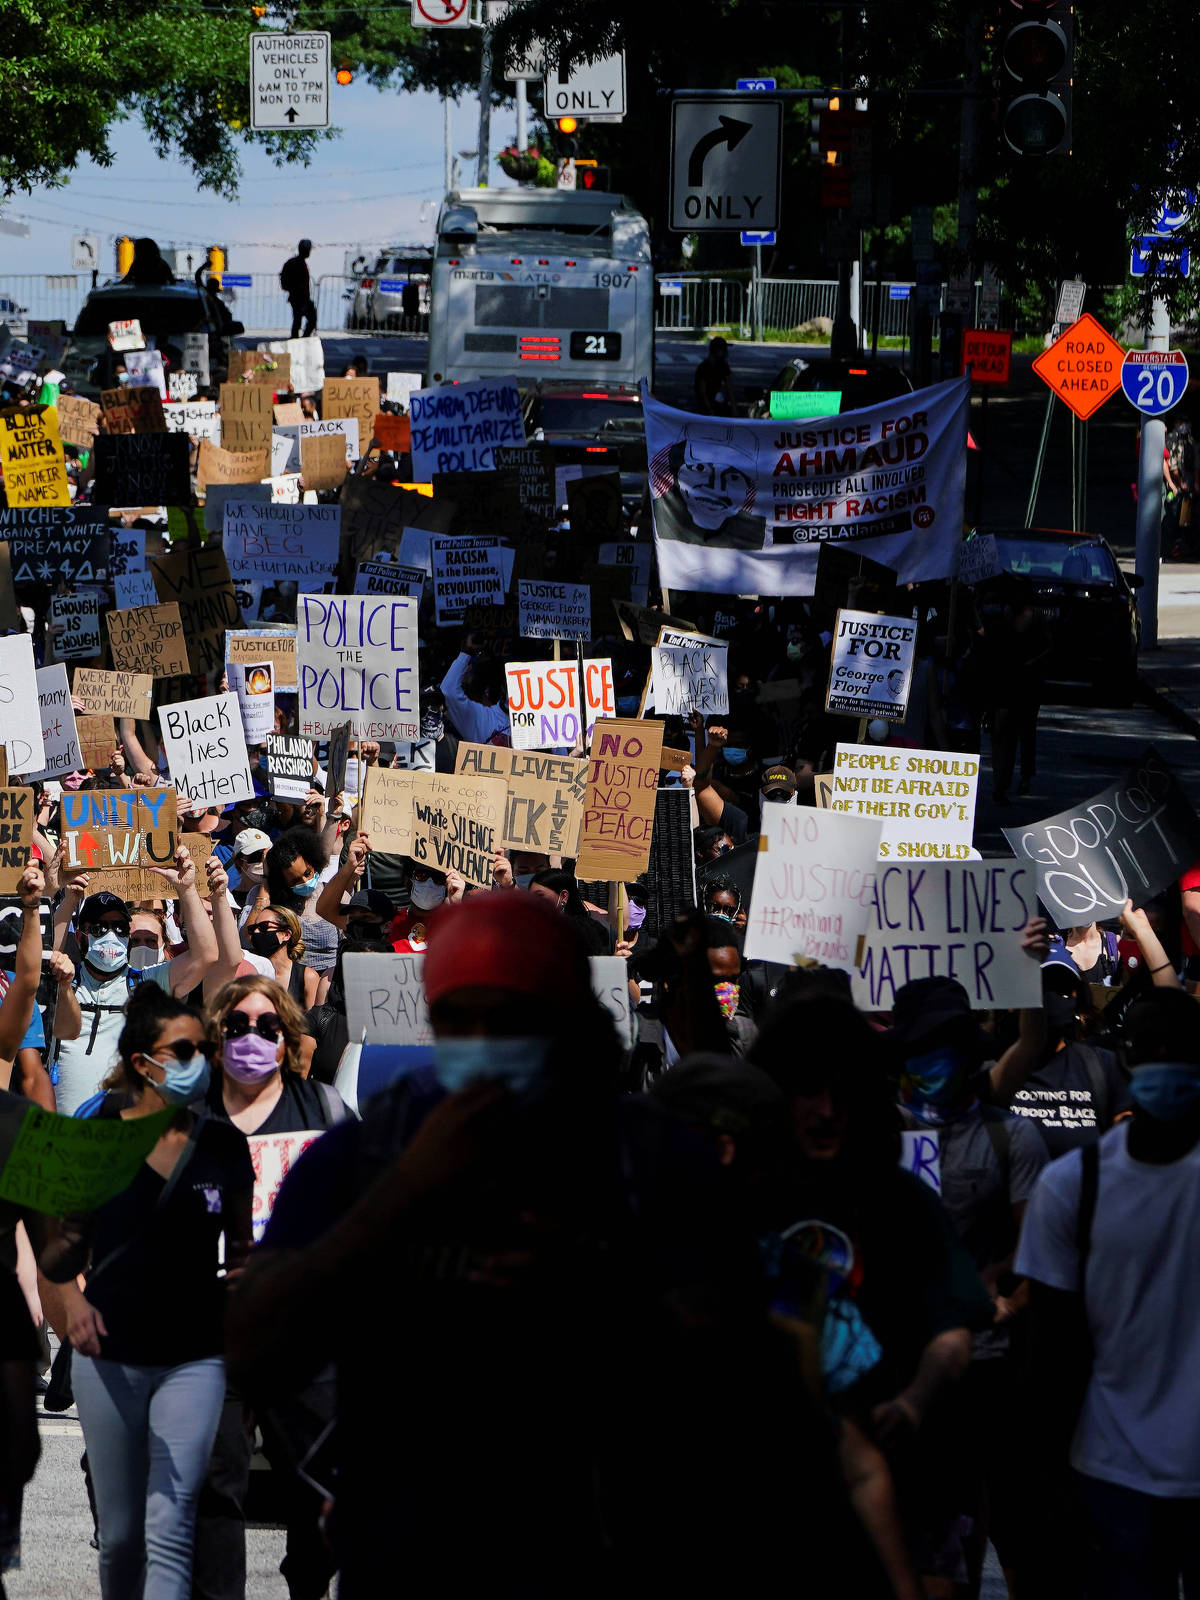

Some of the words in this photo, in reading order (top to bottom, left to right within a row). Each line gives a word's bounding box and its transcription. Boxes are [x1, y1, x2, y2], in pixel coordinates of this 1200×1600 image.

[257, 38, 324, 50] AUTHORIZED
[262, 53, 318, 65] VEHICLES
[274, 68, 306, 80] ONLY
[258, 82, 281, 93] 6AM
[285, 82, 298, 92] TO
[301, 82, 323, 92] 7PM
[260, 95, 284, 105] MON
[287, 95, 301, 104] TO
[304, 94, 322, 104] FRI
[557, 90, 615, 110] ONLY
[684, 196, 762, 220] ONLY
[454, 271, 494, 280] marta
[593, 274, 632, 288] 1907
[585, 336, 607, 354] 21
[1066, 342, 1105, 354] ROAD
[1057, 361, 1113, 374] CLOSED
[1132, 353, 1177, 363] INTERSTATE
[1060, 379, 1109, 392] AHEAD
[1137, 371, 1175, 407] 20
[5, 410, 47, 432] BLACK
[301, 421, 344, 434] BLACK
[774, 424, 871, 450] JUSTICE
[881, 411, 928, 439] FOR
[411, 414, 523, 452] DEMILITARIZE
[8, 439, 57, 462] MATTER
[773, 433, 930, 477] AHMAUD
[772, 475, 842, 497] PROSECUTE
[845, 474, 869, 493] ALL
[871, 467, 926, 489] INVOLVED
[226, 505, 248, 519] WE
[250, 505, 304, 521] SHOULD
[308, 506, 340, 521] NOT
[774, 501, 838, 521] FIGHT
[846, 486, 927, 518] RACISM
[64, 522, 105, 538] WHITE
[446, 550, 488, 565] RACISM
[447, 567, 461, 577] the
[463, 565, 499, 577] Disease,
[368, 577, 410, 595] RACISM
[437, 579, 500, 596] REVOLUTION
[521, 583, 566, 599] JUSTICE
[573, 588, 587, 600] for
[53, 599, 98, 617] ENOUGH
[520, 601, 555, 612] GEORGE
[559, 603, 585, 615] FLOYD
[66, 617, 81, 630] IS
[107, 608, 160, 630] MAKE
[303, 597, 409, 652] POLICE
[527, 615, 561, 625] AHMAUD
[562, 616, 591, 628] ARBERY
[54, 630, 99, 648] ENOUGH
[110, 627, 147, 646] COPS
[149, 622, 182, 639] STOP
[839, 620, 914, 642] JUSTICE
[116, 640, 164, 661] KILLING
[336, 651, 363, 663] THE
[849, 638, 901, 661] FOR
[660, 650, 718, 680] BLACK
[836, 666, 884, 684] George
[76, 683, 107, 697] ASKING
[111, 684, 131, 699] FOR
[302, 664, 412, 712] POLICE
[833, 679, 871, 696] Floyd
[81, 697, 101, 711] TOO
[104, 699, 137, 714] MUCH!
[167, 702, 231, 740] Black
[188, 737, 229, 764] lives
[266, 734, 313, 759] PHILANDO
[598, 733, 644, 758] NO
[268, 756, 313, 777] RAYSHARD
[460, 748, 505, 775] ALL
[510, 754, 576, 784] LIVES
[588, 759, 660, 791] JUSTICE
[836, 751, 900, 772] PEOPLE
[906, 756, 978, 778] SHOULD
[175, 768, 252, 801] Matter!
[834, 775, 869, 794] NOT
[871, 777, 894, 795] BE
[895, 778, 970, 798] AFRAID
[592, 788, 632, 810] NO
[62, 792, 167, 829] UNITY
[832, 799, 856, 814] OF
[857, 800, 911, 818] THEIR
[914, 801, 970, 822] GOV'T.
[0, 823, 22, 844] BE
[416, 801, 448, 831] White
[448, 812, 495, 855] SILENCE
[584, 810, 654, 842] PEACE
[780, 814, 819, 847] NO
[414, 837, 428, 860] is
[433, 834, 494, 886] VIOLENCE
[897, 841, 971, 860] SHOULD
[1069, 1090, 1092, 1102] FOR
[1058, 1105, 1097, 1121] BLACK
